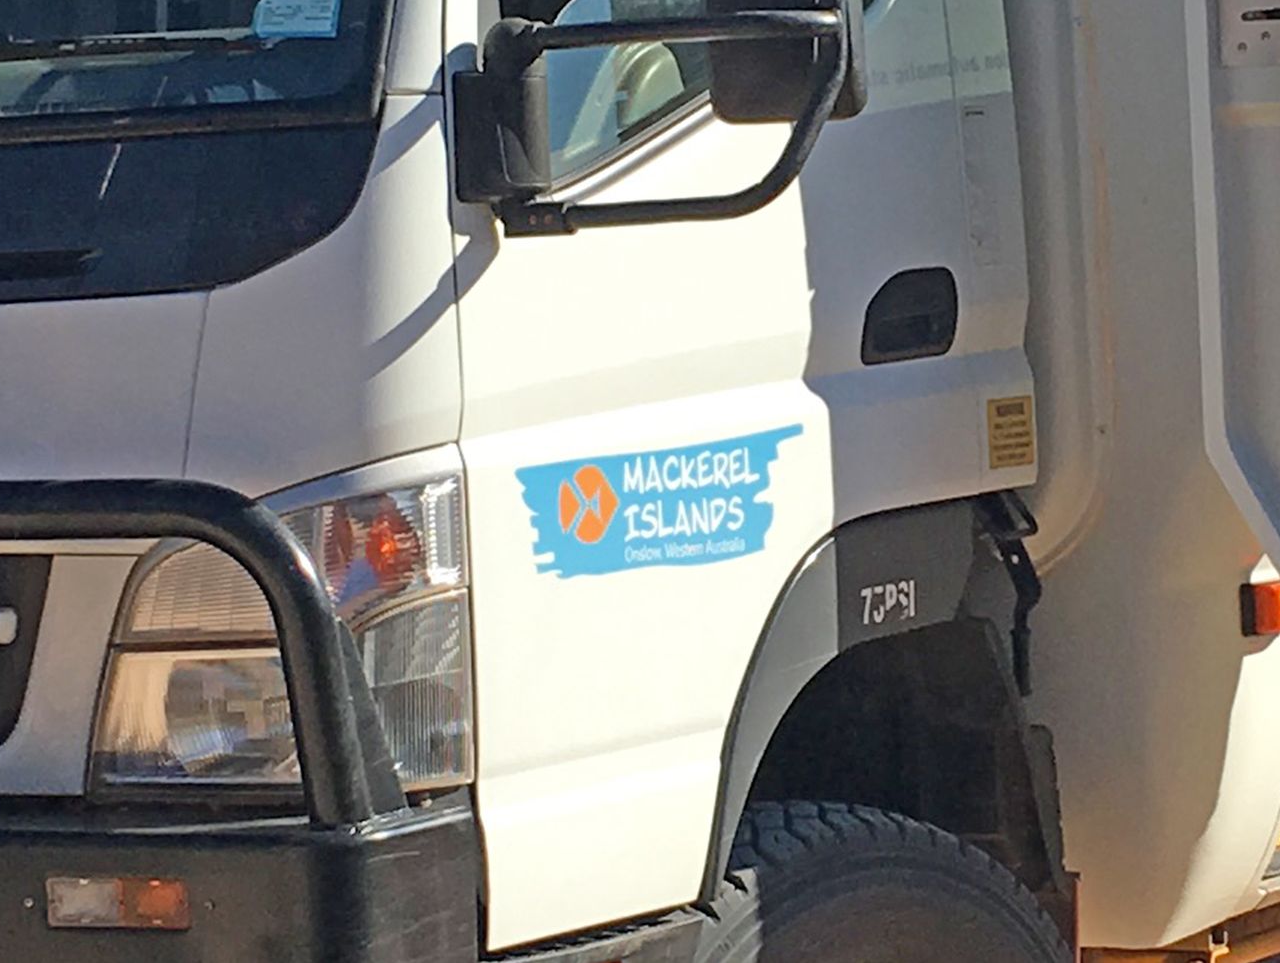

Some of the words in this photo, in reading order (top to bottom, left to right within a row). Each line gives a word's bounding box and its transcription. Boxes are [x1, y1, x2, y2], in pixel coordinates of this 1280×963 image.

[623, 447, 760, 494] MACKEREL
[623, 497, 745, 542] ISLANDS
[664, 542, 705, 559] Western
